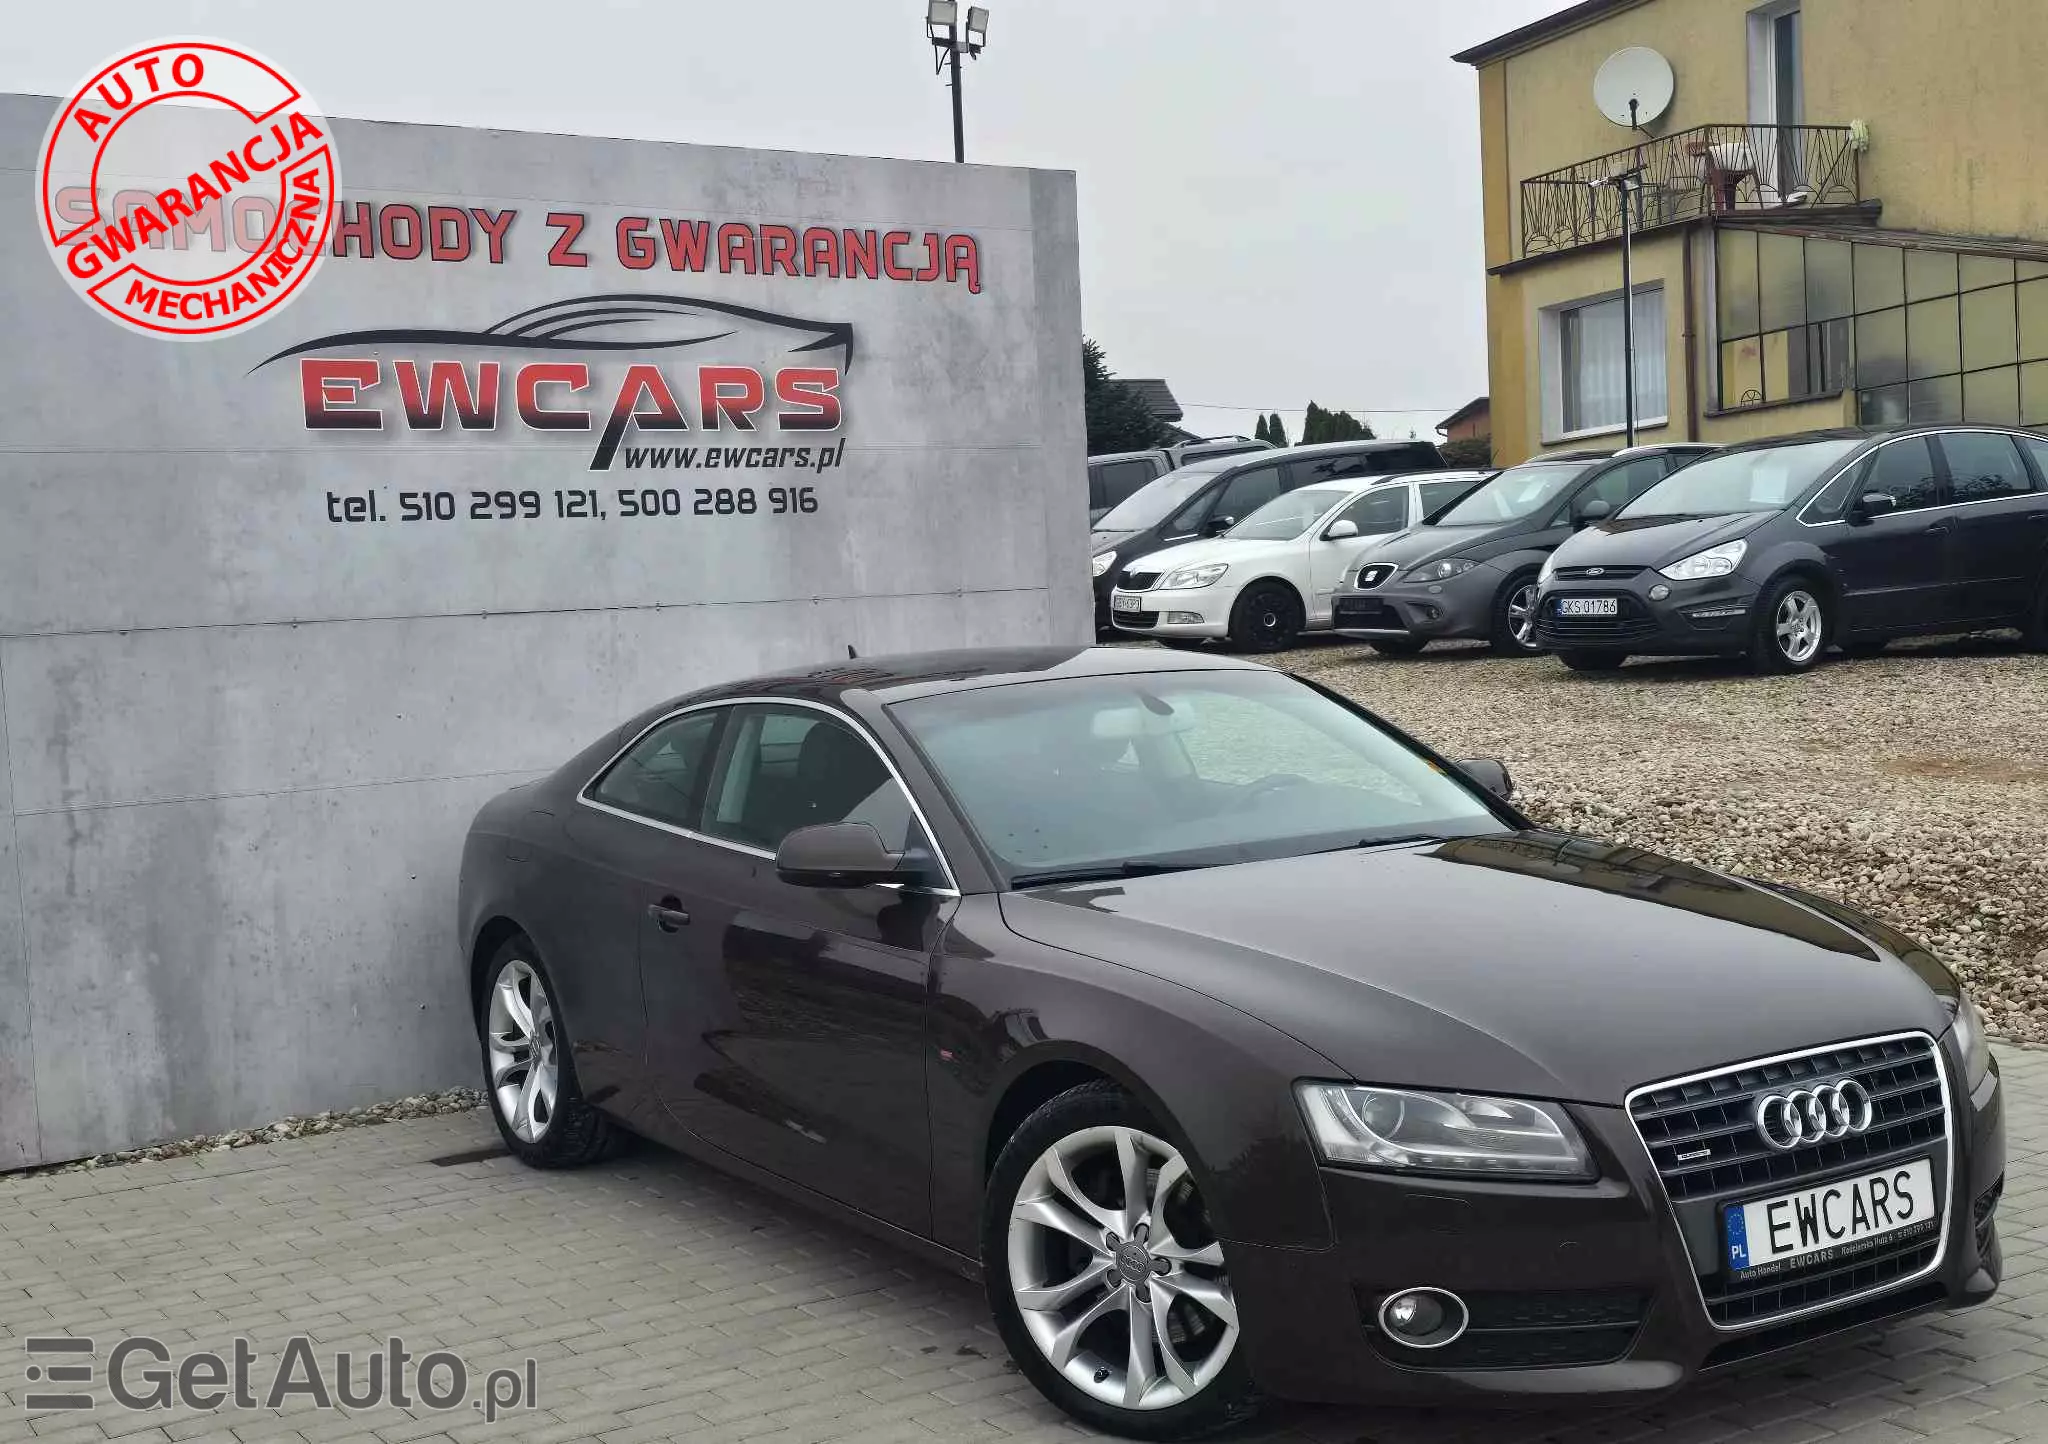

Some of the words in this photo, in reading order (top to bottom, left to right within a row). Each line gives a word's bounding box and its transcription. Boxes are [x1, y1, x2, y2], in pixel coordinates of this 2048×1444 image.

[546, 212, 589, 267] Z
[616, 216, 981, 294] GWARANCJĄ
[300, 358, 842, 472] EWCARS
[624, 437, 846, 474] www.ewcars.pl
[327, 490, 386, 522] tel.
[400, 491, 456, 521] 510
[470, 490, 541, 520] 299
[554, 489, 606, 521] 121,
[618, 488, 681, 517] 500
[694, 488, 757, 515] 288
[768, 487, 819, 513] 916
[1584, 600, 1616, 613] 01786
[1731, 1243, 1746, 1259] PL
[1767, 1170, 1914, 1255] EWCARS
[1790, 1249, 1833, 1269] EWCARS
